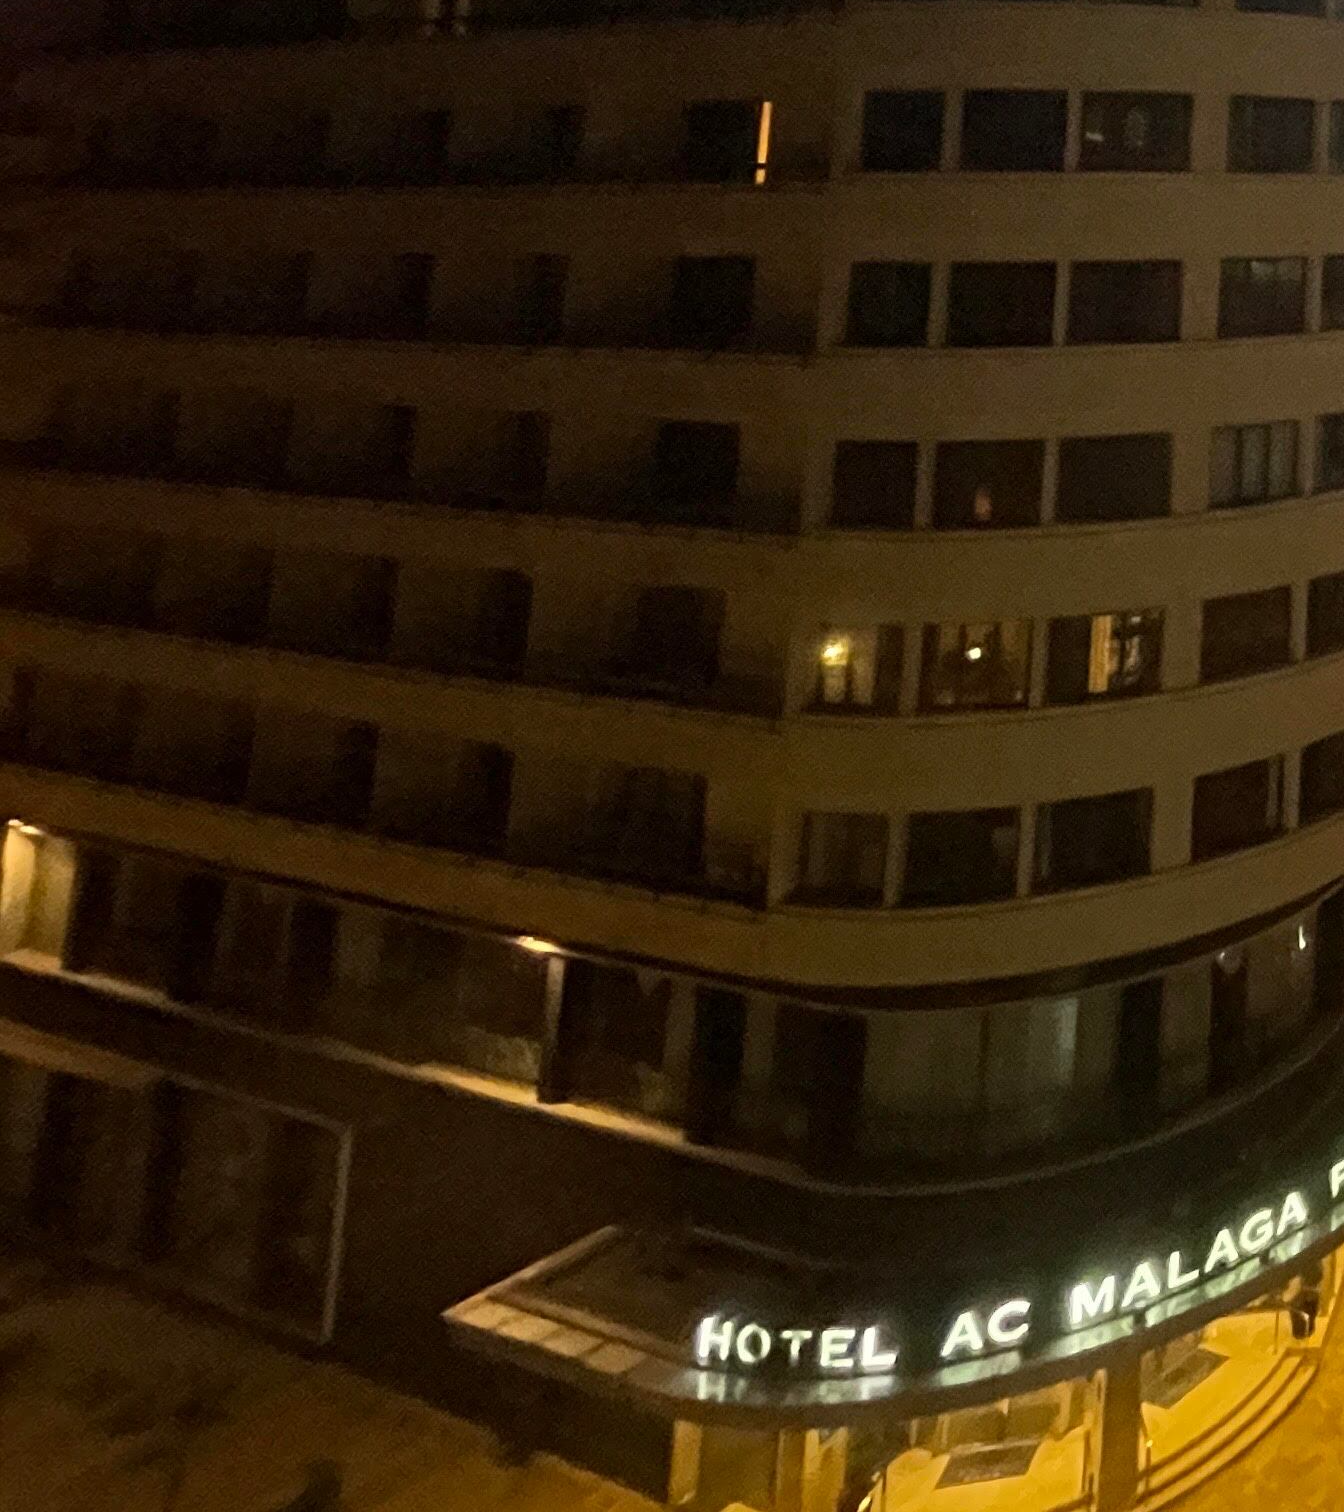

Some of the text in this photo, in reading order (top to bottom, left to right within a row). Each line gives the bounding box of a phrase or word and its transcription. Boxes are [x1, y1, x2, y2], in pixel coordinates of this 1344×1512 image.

[697, 1316, 898, 1369] HOTEL
[939, 1298, 1032, 1358] AC
[1070, 1190, 1308, 1325] MALAGA
